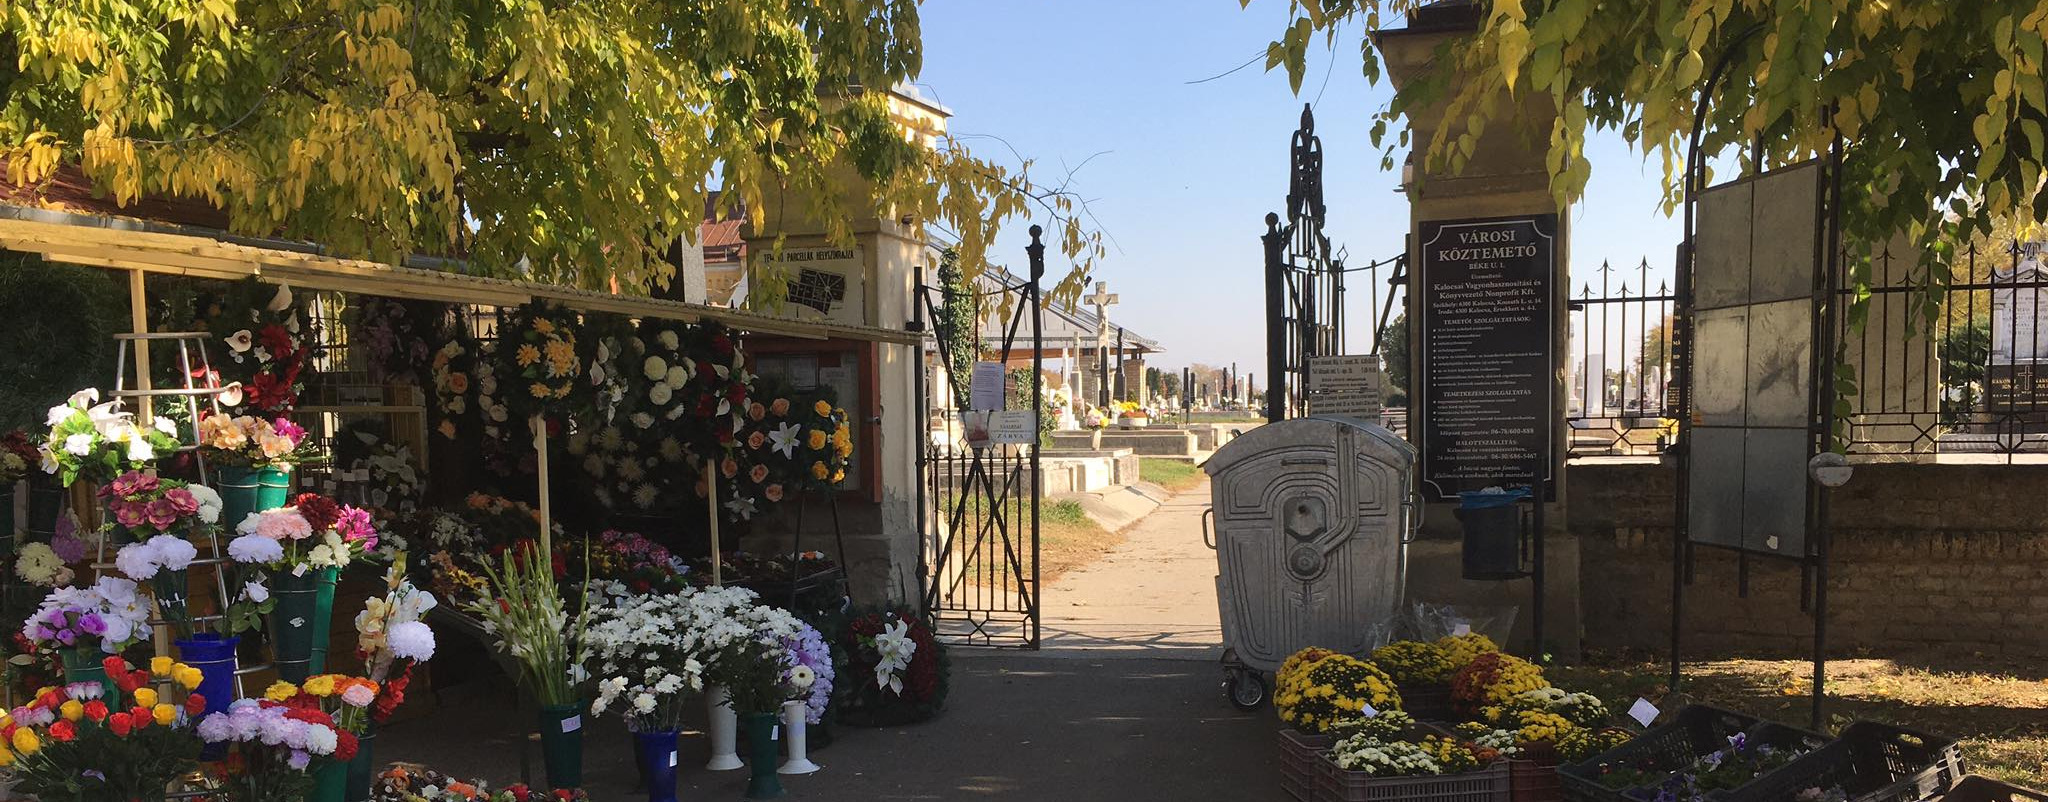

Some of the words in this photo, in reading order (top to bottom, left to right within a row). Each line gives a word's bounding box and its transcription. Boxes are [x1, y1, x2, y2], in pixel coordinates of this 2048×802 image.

[1459, 230, 1515, 244] VÁROSI
[1438, 242, 1537, 262] KÖZTEMETŐ
[1466, 281, 1532, 290] Vagyonhasznosítási
[1440, 291, 1484, 300] Könyvvezető
[1485, 290, 1519, 298] Nonprofit
